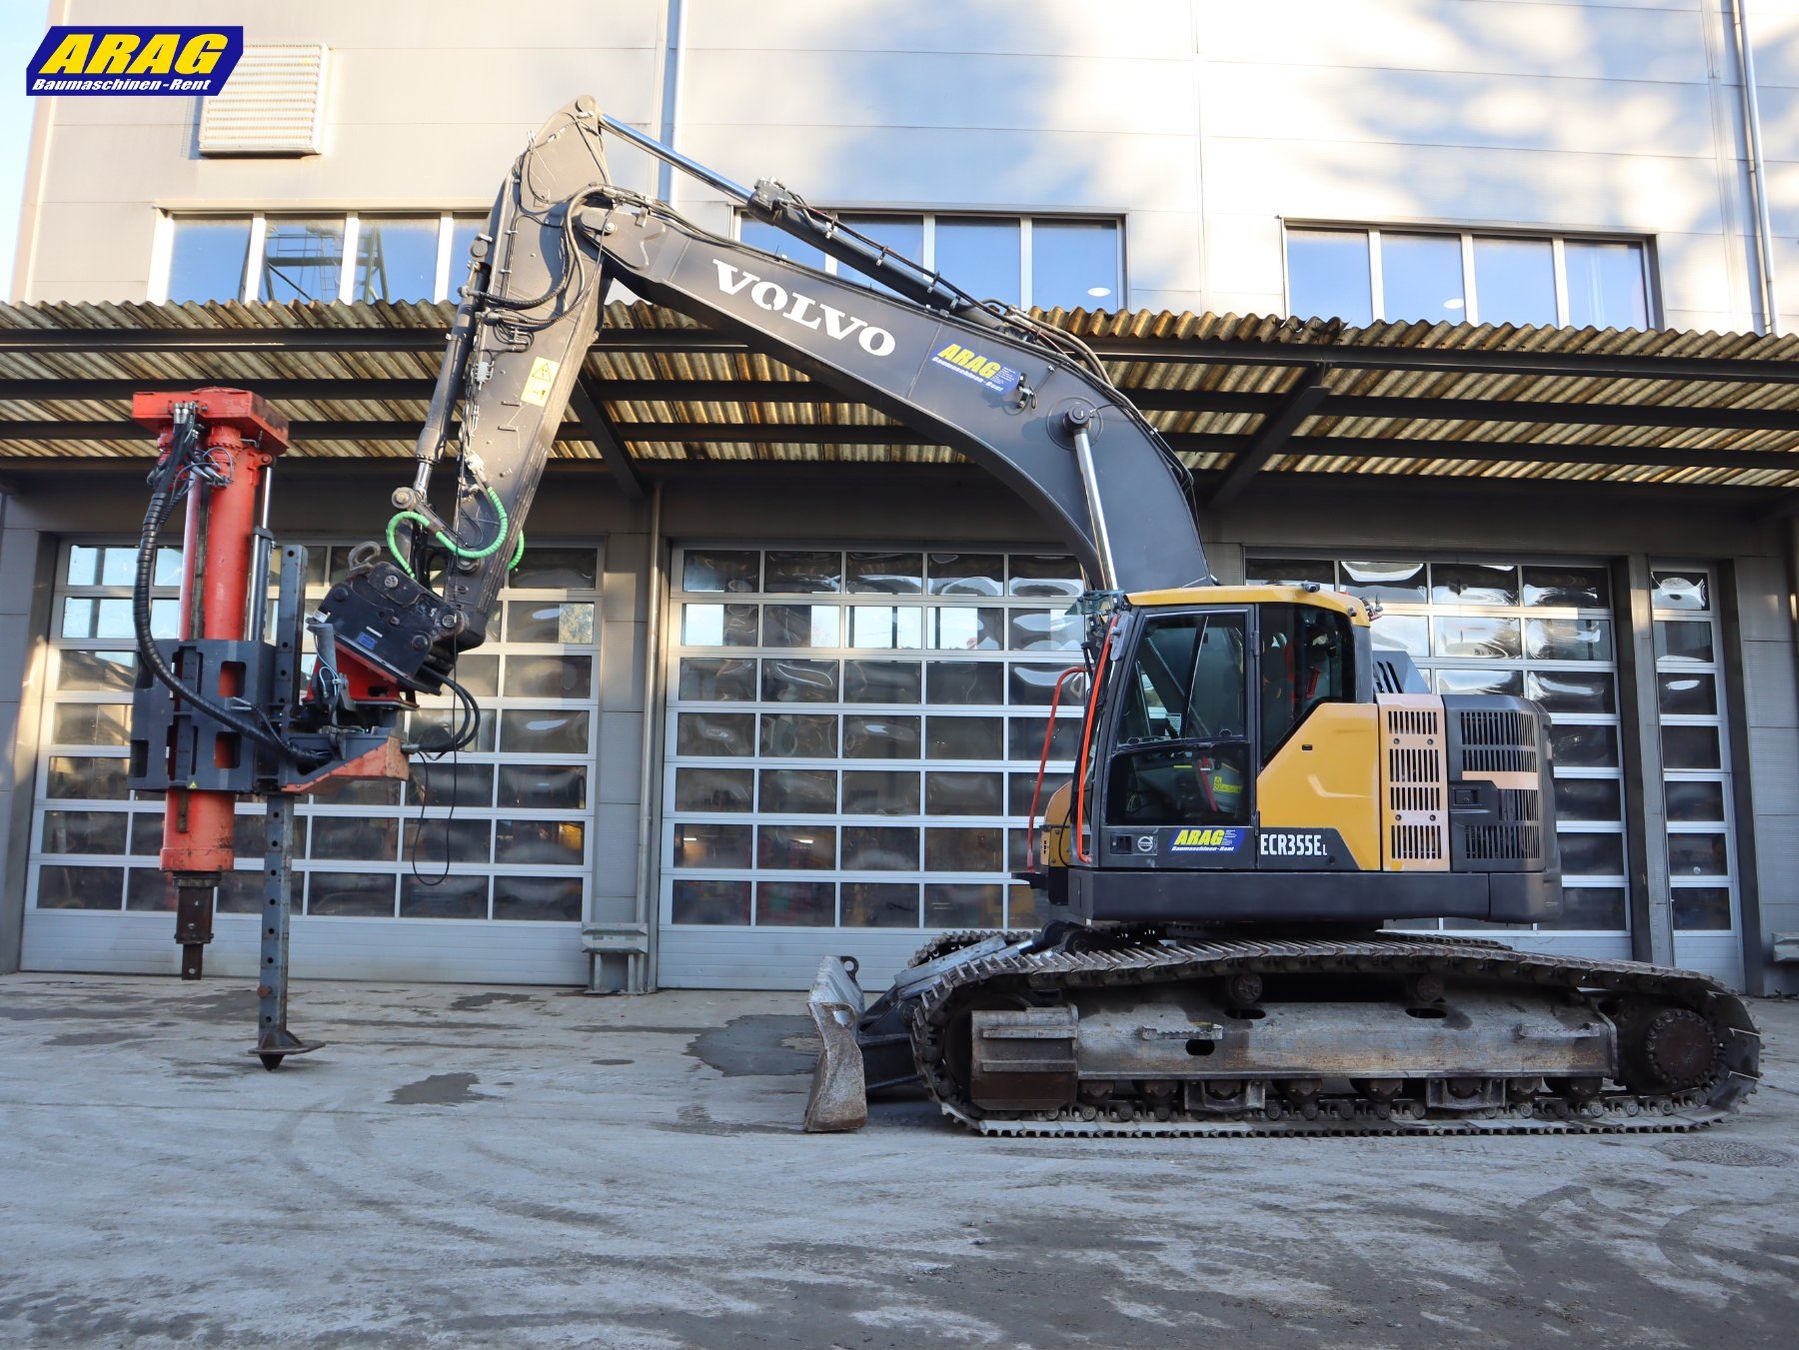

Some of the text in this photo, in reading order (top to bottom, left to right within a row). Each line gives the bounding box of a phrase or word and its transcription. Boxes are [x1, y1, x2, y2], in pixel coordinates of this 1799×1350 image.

[712, 258, 896, 357] VOLVO
[937, 343, 1001, 379] ARAG
[1174, 829, 1225, 846] ARAG
